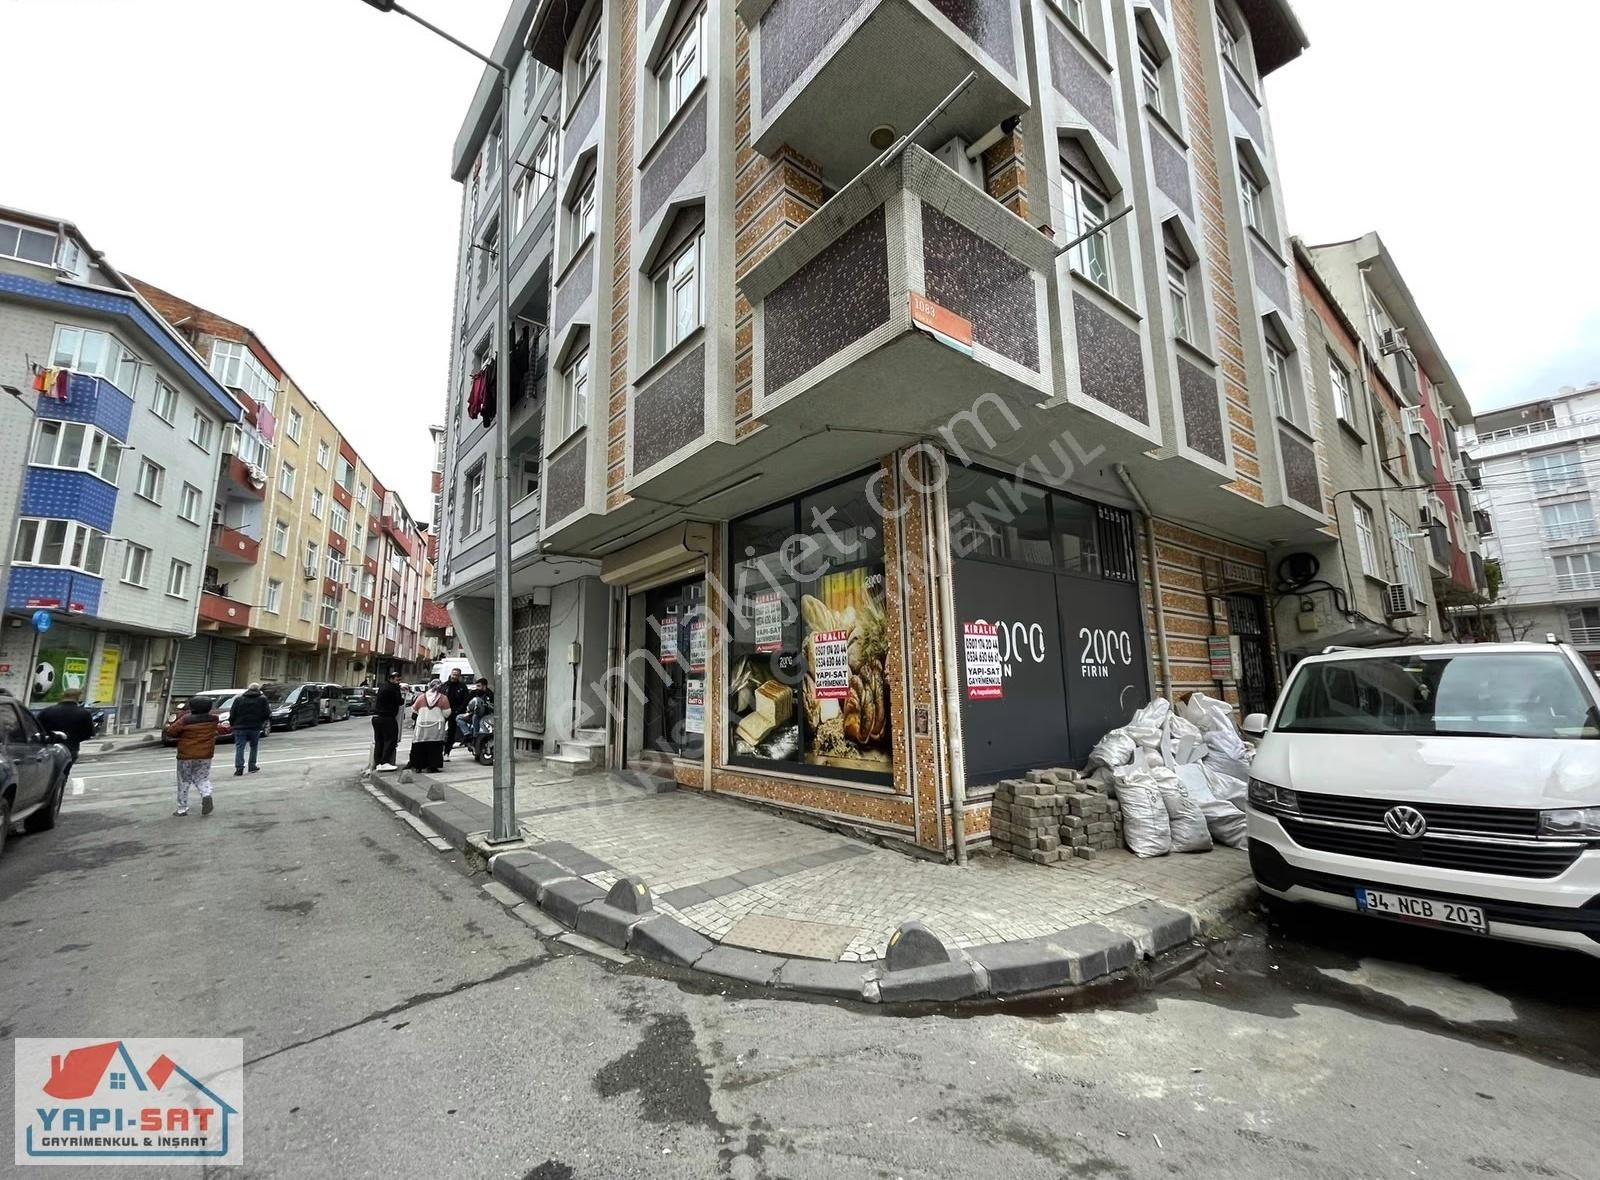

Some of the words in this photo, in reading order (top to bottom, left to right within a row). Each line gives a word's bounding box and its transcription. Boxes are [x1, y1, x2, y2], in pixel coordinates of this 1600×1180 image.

[1080, 628, 1132, 665] 2000
[816, 670, 847, 678] YAPI-SAT
[968, 667, 1000, 675] YAPI-SAT
[1082, 665, 1109, 678] FIRIN
[1367, 892, 1388, 910] 34
[1398, 896, 1434, 918] NCB
[1444, 904, 1482, 926] 203
